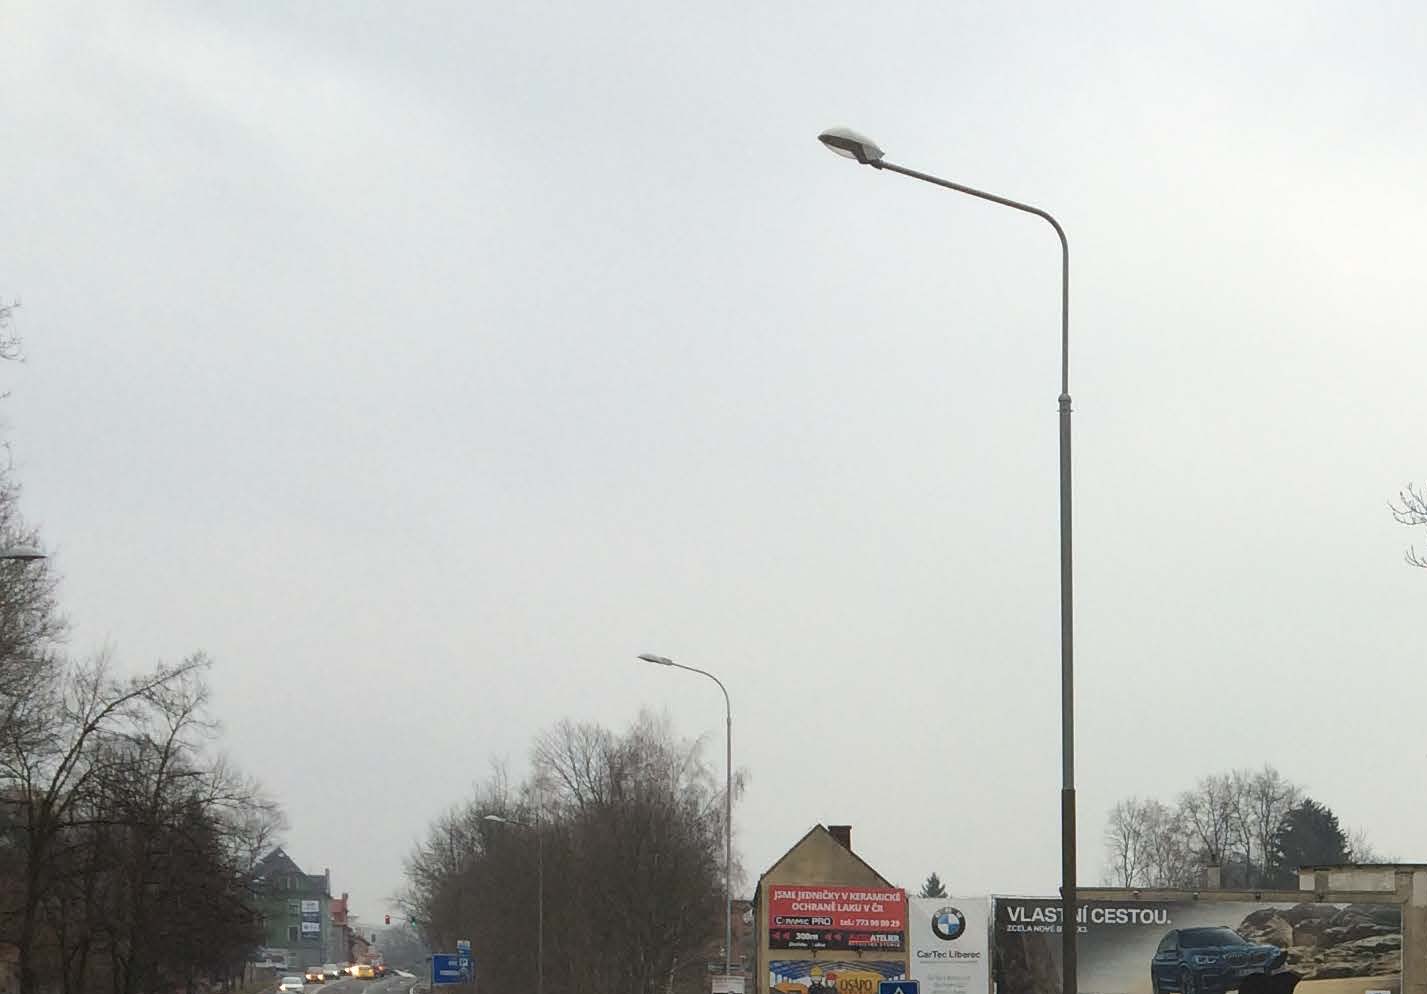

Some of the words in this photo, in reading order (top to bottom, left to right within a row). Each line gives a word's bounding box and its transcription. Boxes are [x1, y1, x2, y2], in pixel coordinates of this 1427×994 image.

[792, 901, 836, 912] OCHRANĚ
[1091, 907, 1172, 925] CESTOU.
[811, 918, 830, 926] PRO
[917, 950, 946, 959] CarTec
